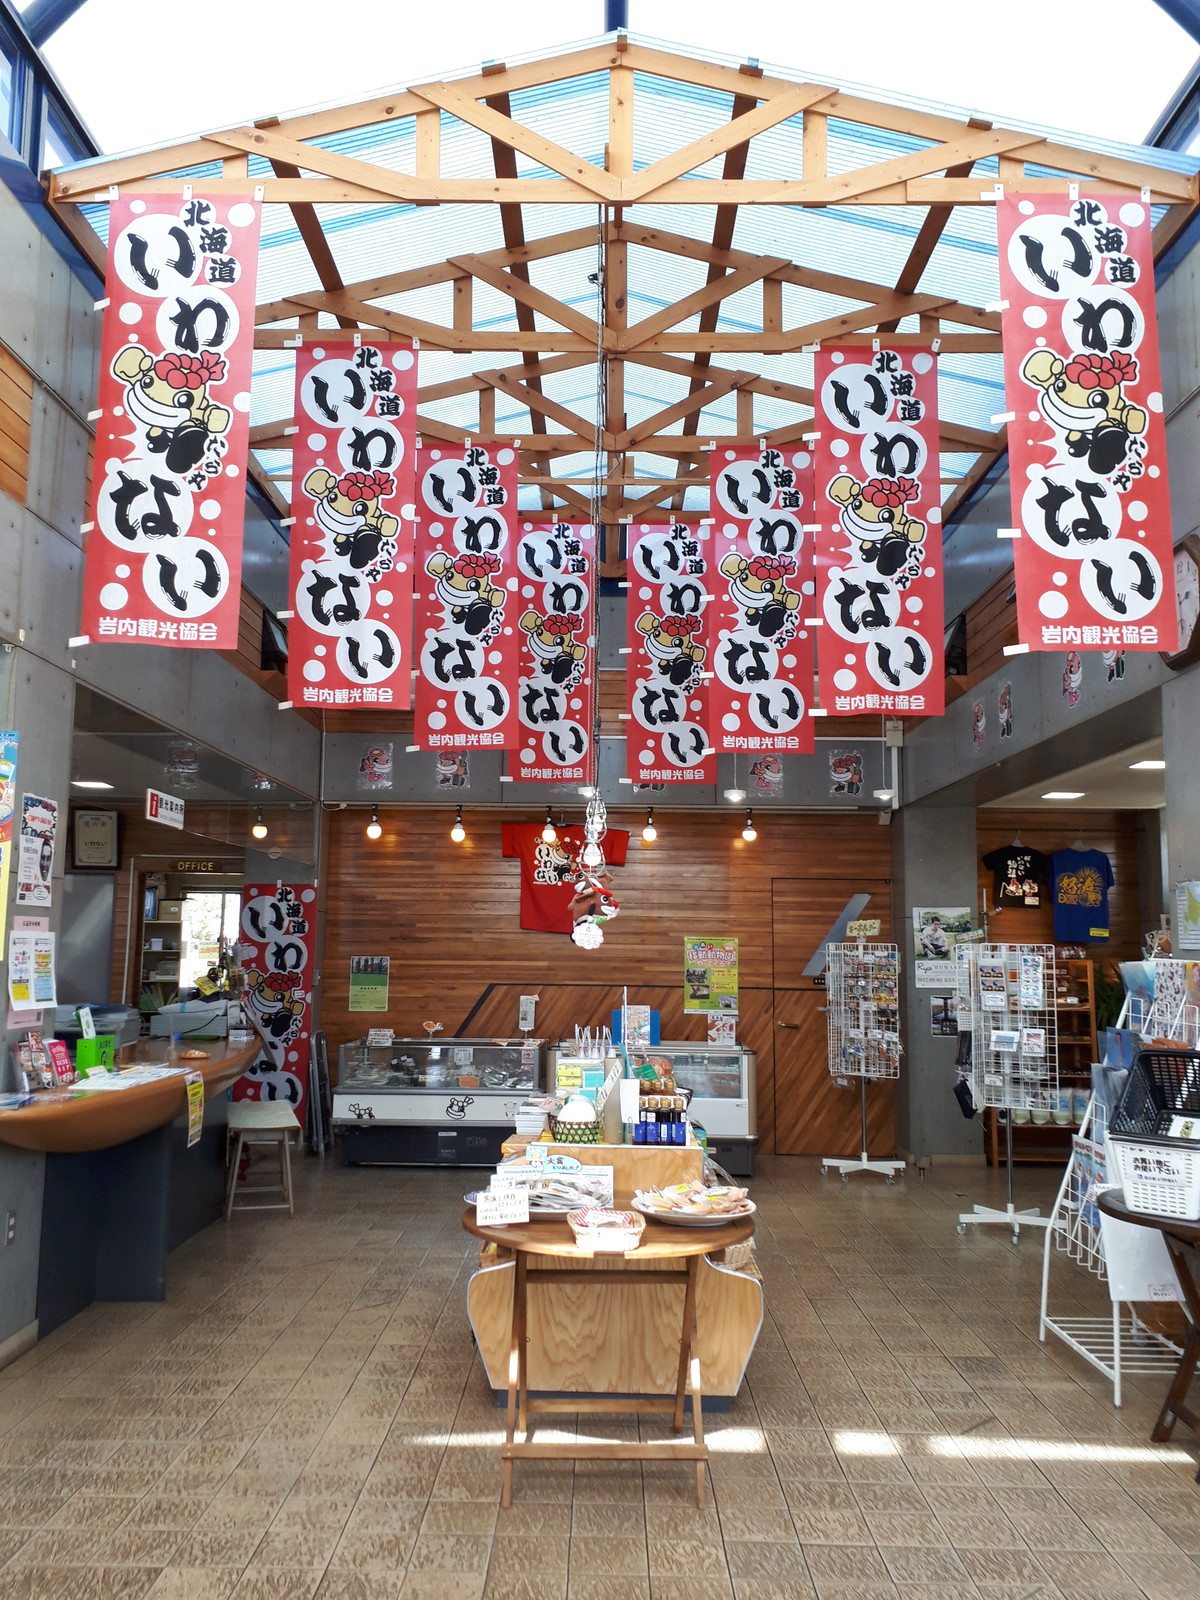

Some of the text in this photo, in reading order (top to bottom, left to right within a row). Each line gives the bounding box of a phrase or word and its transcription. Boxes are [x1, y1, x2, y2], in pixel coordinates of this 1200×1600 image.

[184, 200, 237, 284] 北海道
[1074, 201, 1136, 283] 北海道
[356, 348, 401, 416] 北海道
[876, 351, 921, 421] 北海道
[108, 226, 229, 612] いわない
[1019, 228, 1155, 615] いわない
[467, 449, 505, 505] 北海道
[762, 451, 800, 509] 北海道
[306, 368, 397, 679] いわない
[555, 523, 586, 574] 北海道
[672, 524, 704, 575] 北海道
[831, 374, 924, 686] いわない
[430, 467, 505, 726] いわない
[723, 469, 799, 729] いわない
[98, 617, 218, 642] 岩内観光協会
[522, 539, 584, 762] いわない
[639, 540, 704, 763] いわない
[1041, 624, 1158, 645] 岩内観光協会
[303, 687, 393, 703] 岩内観光協会
[835, 694, 926, 711] 岩内観光協会
[428, 733, 505, 747] 岩内観光協会
[722, 736, 799, 749] 岩内観光協会
[520, 767, 583, 779] 岩内観光協会
[639, 769, 704, 780] 岩内観光協会
[177, 860, 215, 872] OFFICE
[277, 887, 306, 935] 北海道
[1133, 1157, 1171, 1168] お買い物に
[1134, 1164, 1180, 1175] お使い下さい
